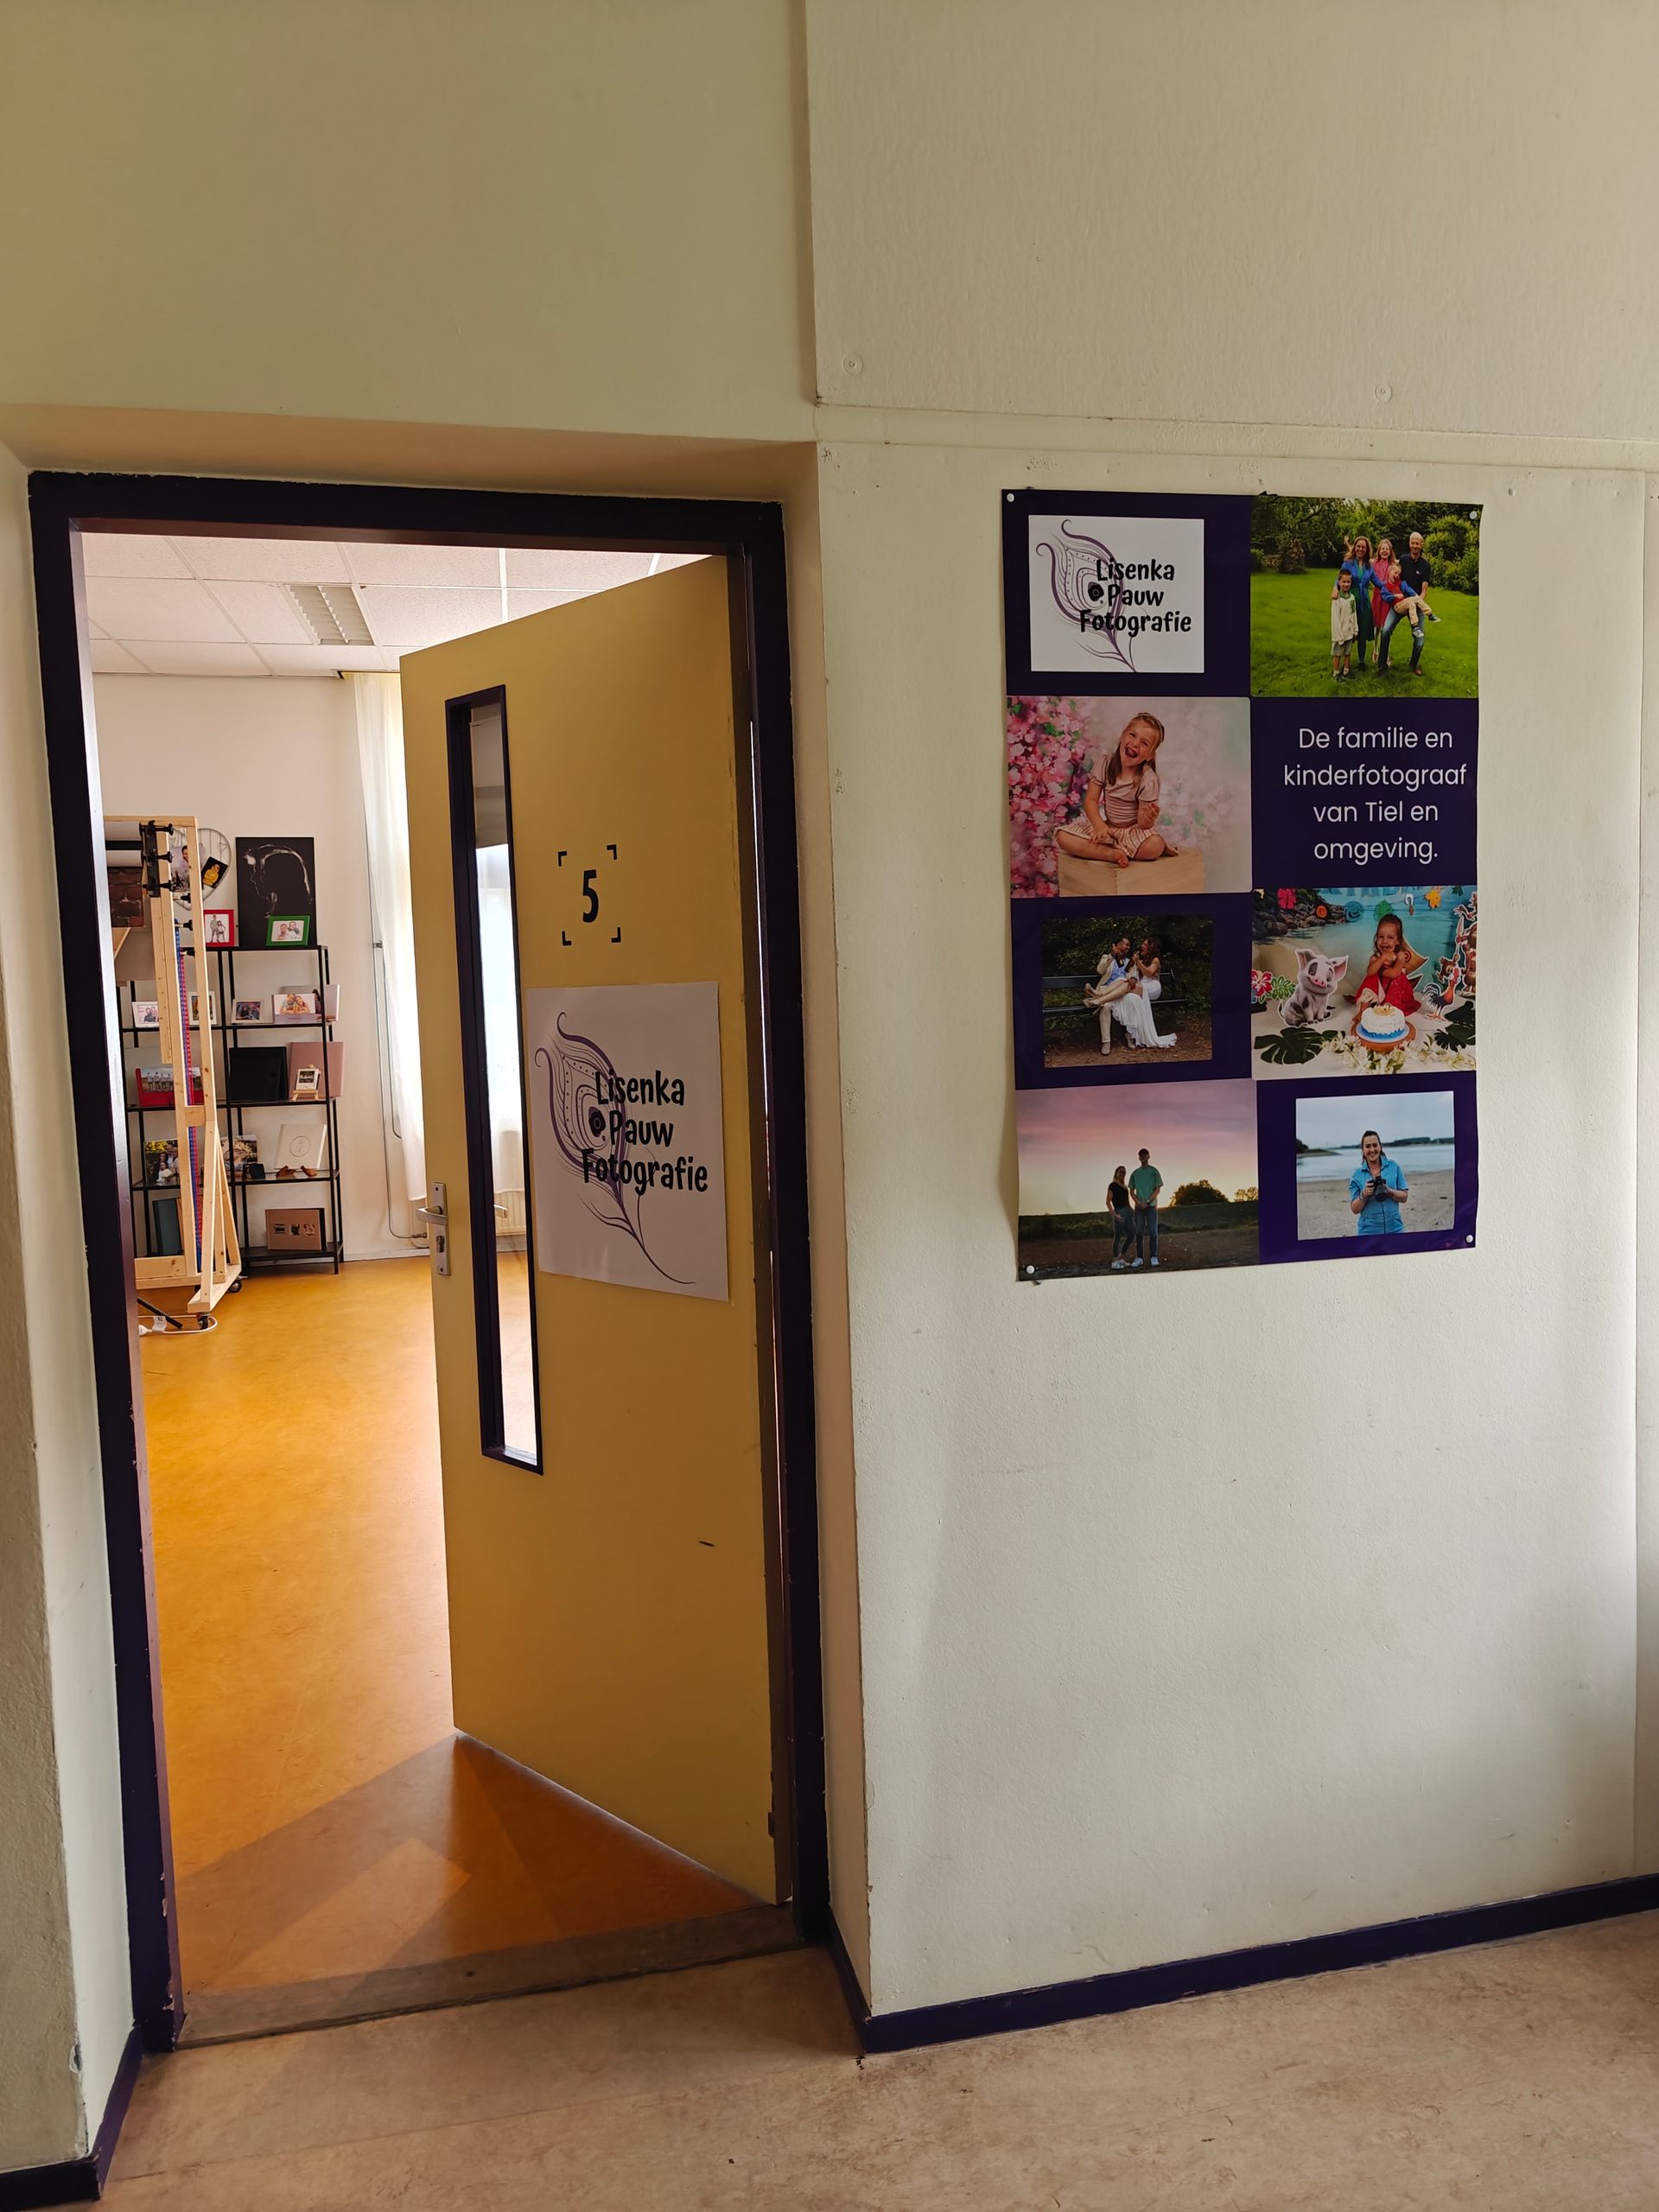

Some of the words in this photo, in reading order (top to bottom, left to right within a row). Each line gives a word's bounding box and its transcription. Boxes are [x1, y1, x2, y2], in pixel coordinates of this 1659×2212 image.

[1096, 556, 1175, 582] Lisenka
[1107, 583, 1164, 607] Pauw
[1078, 608, 1192, 639] Fotografie
[1299, 728, 1331, 749] De
[1337, 726, 1418, 749] familie
[1425, 732, 1453, 749] en
[1283, 762, 1467, 792] kinderfotograaf
[1313, 805, 1357, 823] van
[1364, 799, 1403, 823] Tiel
[1410, 804, 1439, 822] en
[1313, 836, 1439, 866] omgeving.
[582, 869, 600, 924] 5
[595, 1070, 685, 1107] Lisenka
[608, 1109, 674, 1147] Pauw
[580, 1147, 709, 1197] Fotografie
